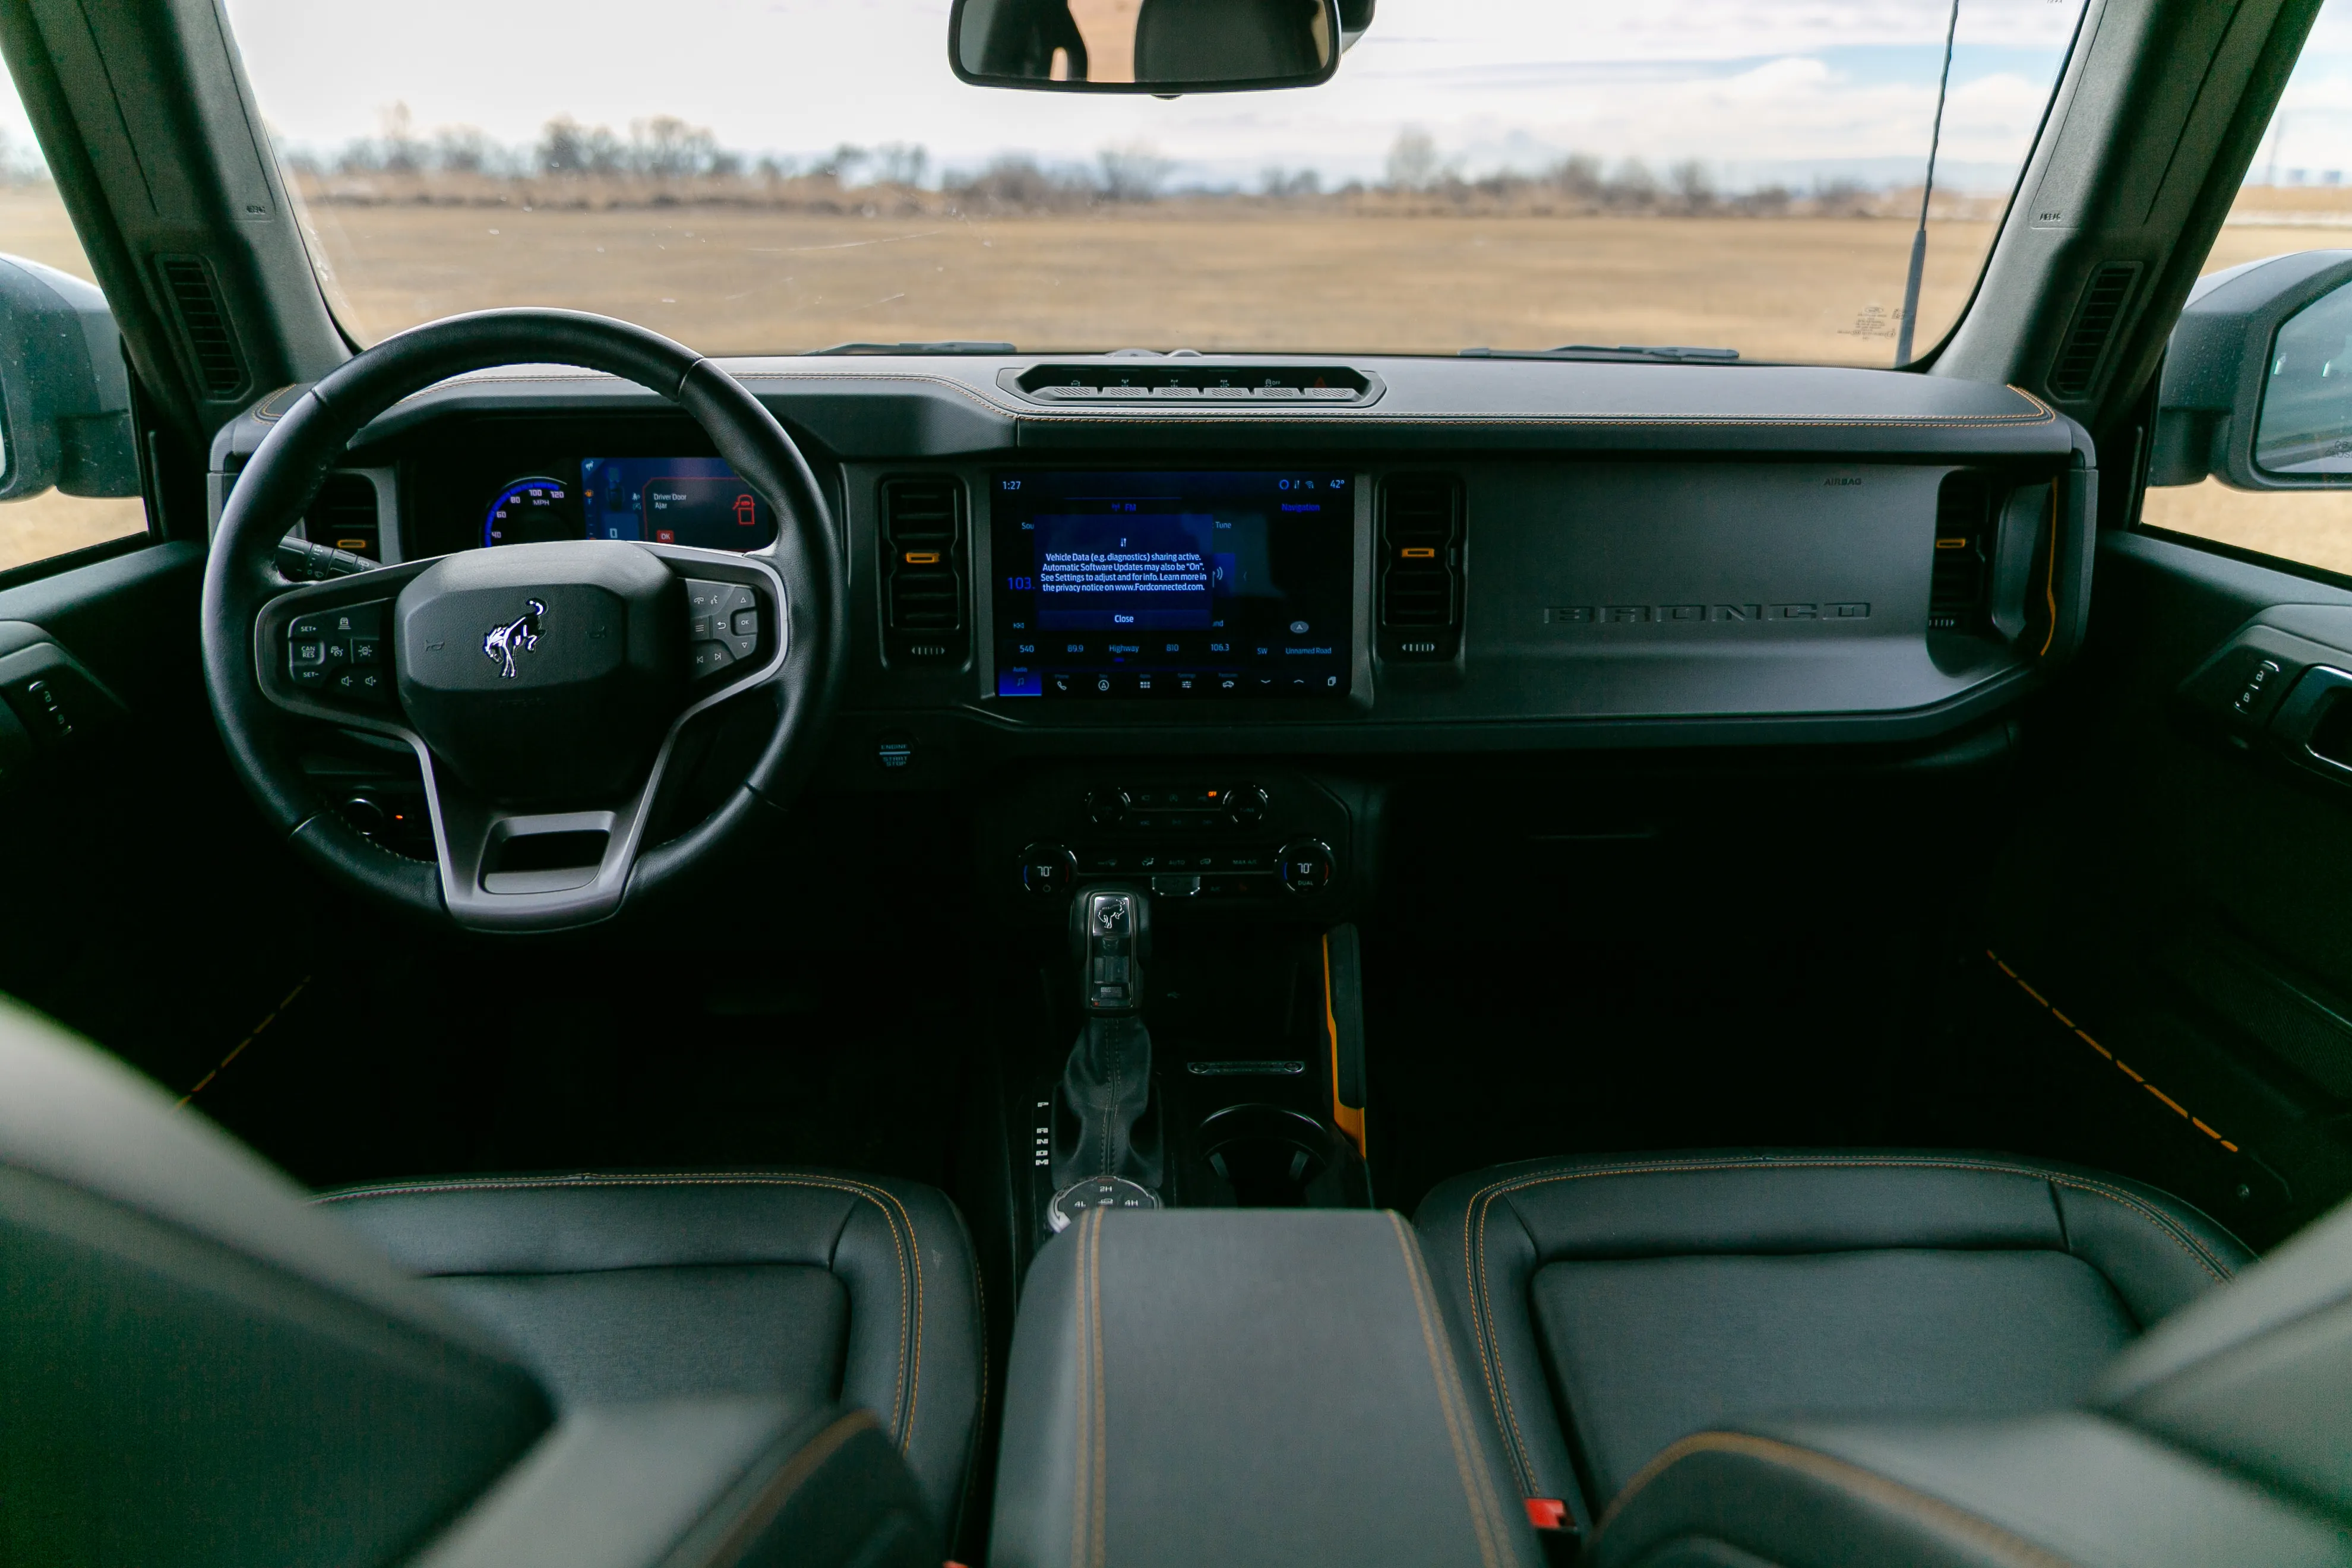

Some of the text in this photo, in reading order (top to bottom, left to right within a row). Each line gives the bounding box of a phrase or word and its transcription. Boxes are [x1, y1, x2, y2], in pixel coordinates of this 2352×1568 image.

[1002, 480, 1022, 490] 1:27
[1330, 479, 1345, 489] 42°
[1823, 478, 1862, 486] AIRBAG
[655, 502, 668, 510] Ajar
[1124, 503, 1137, 511] FM
[1281, 503, 1320, 513] Navigation
[496, 510, 507, 519] 60
[1045, 553, 1071, 561] Vehicle
[1072, 553, 1090, 561] Data
[1090, 553, 1106, 562] (e.g.
[1107, 553, 1150, 562] diagnostics)
[1151, 552, 1177, 562] sharing
[1114, 563, 1143, 572] Updates
[1144, 564, 1160, 572] may
[1041, 573, 1054, 581] See
[1055, 573, 1085, 582] Settings
[1094, 573, 1116, 582] adjust
[1143, 573, 1159, 581] info.
[1159, 573, 1180, 581] Learn
[1042, 583, 1054, 592] the
[1055, 583, 1081, 593] privacy
[1082, 583, 1104, 592] notice
[1115, 583, 1205, 591] www.Fordconnected.com.
[1544, 602, 1870, 624] BRONCO
[1114, 615, 1134, 623] Close
[1019, 644, 1035, 653] 540
[1109, 644, 1140, 653] Highway
[1210, 643, 1230, 652] 106.3
